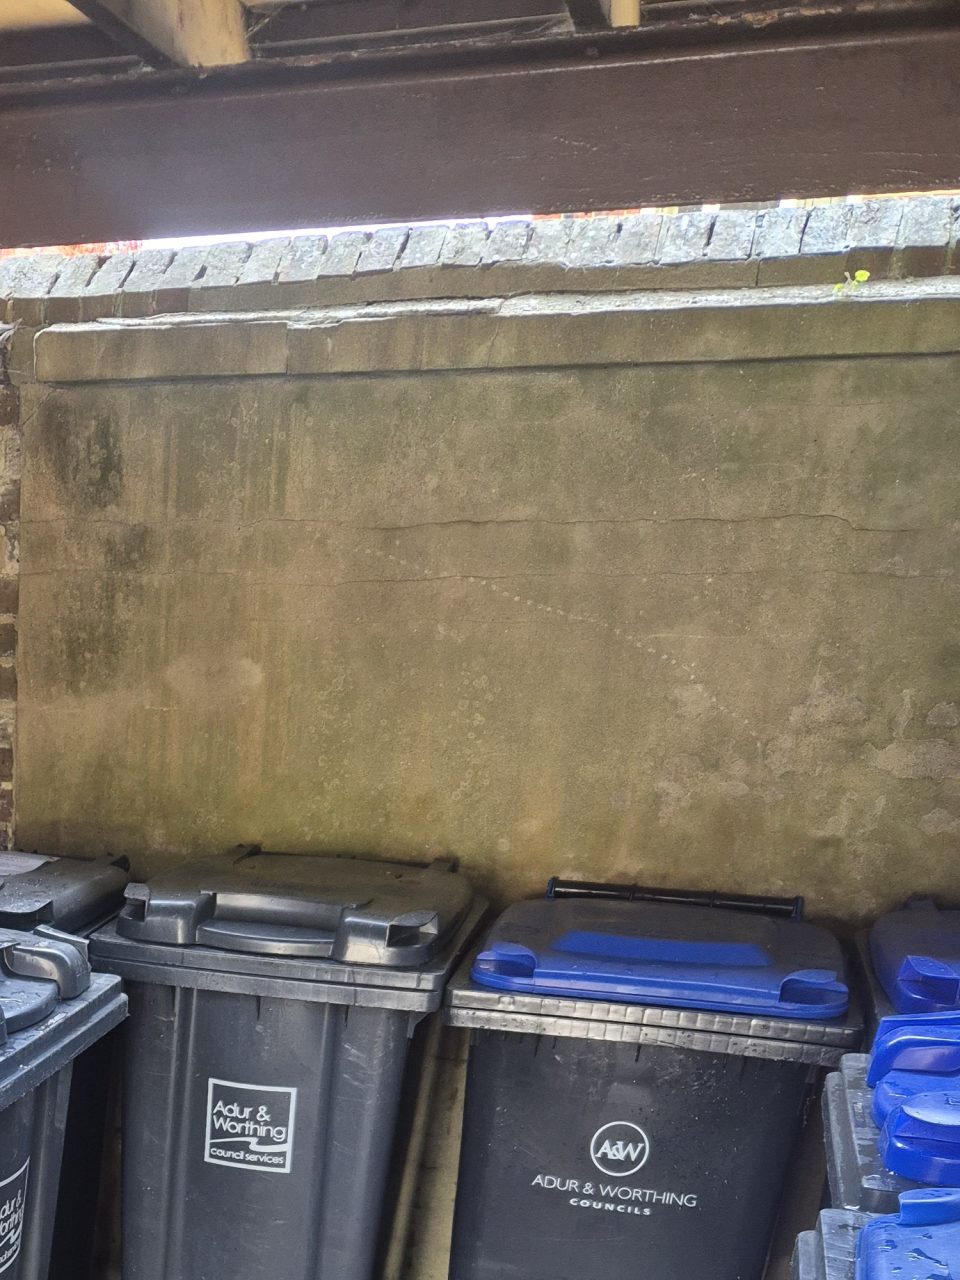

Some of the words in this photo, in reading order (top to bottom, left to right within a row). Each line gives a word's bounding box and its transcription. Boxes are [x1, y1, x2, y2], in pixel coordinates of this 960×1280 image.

[213, 1100, 254, 1119] Adur
[256, 1105, 271, 1122] &
[212, 1115, 287, 1142] Worthing
[210, 1147, 245, 1160] council
[244, 1153, 284, 1164] services
[594, 1139, 645, 1161] A&W
[531, 1174, 579, 1193] ADUR
[582, 1182, 594, 1196] &
[598, 1183, 698, 1208] WORTHING
[569, 1197, 652, 1216] COUNCILS
